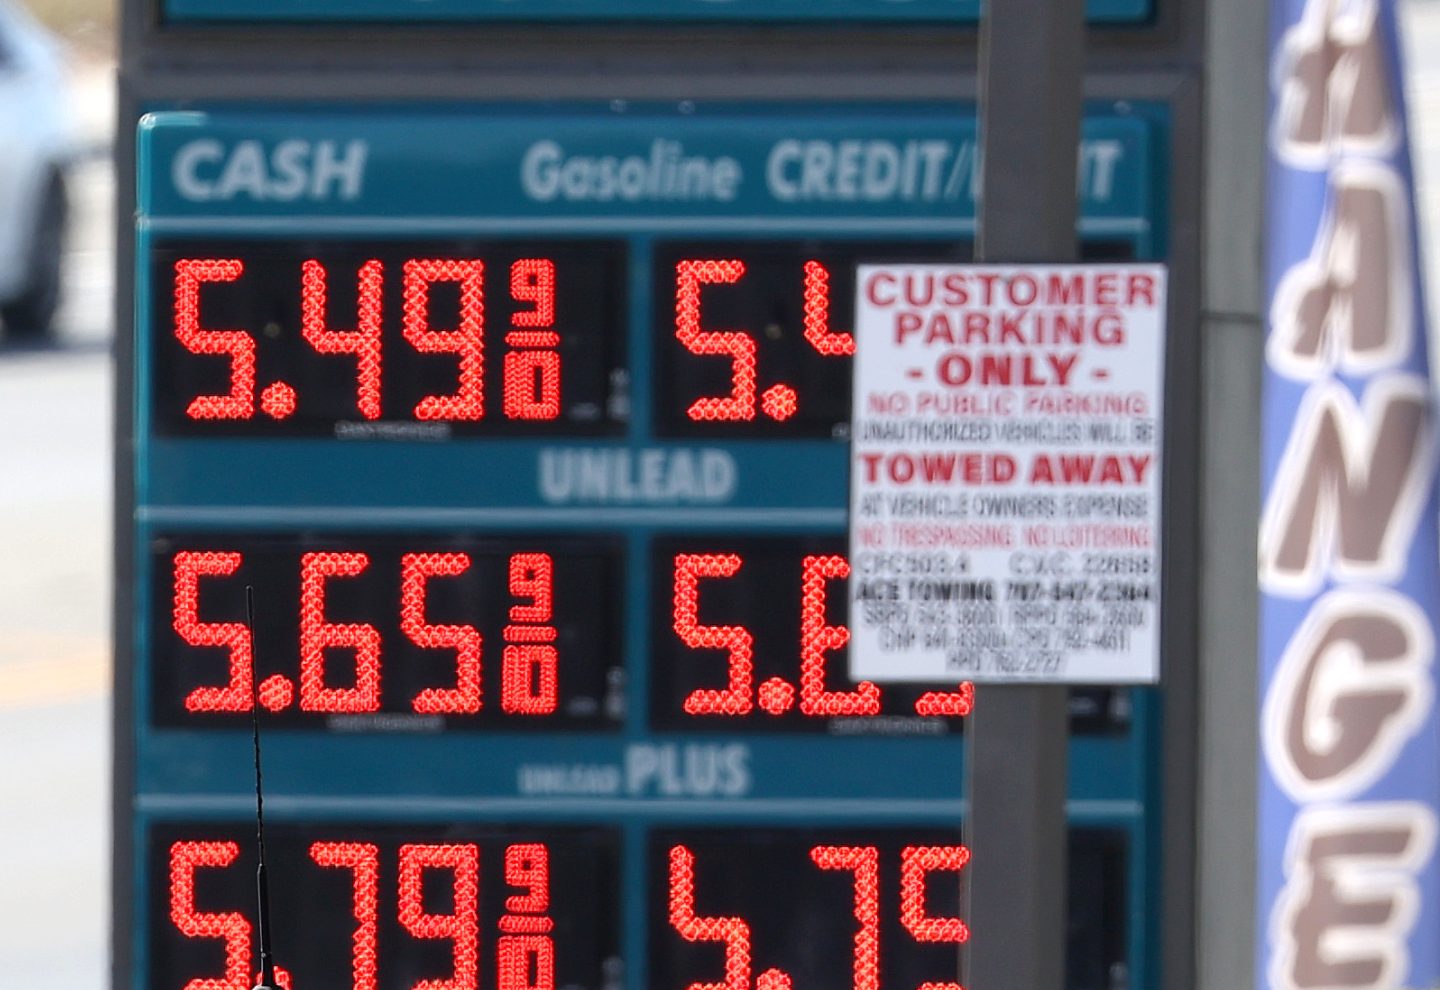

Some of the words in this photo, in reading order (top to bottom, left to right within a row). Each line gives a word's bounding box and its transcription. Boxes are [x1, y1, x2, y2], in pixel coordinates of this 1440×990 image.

[171, 140, 367, 200] CASH
[521, 139, 740, 200] Gasoline
[866, 273, 1155, 306] CUSTOMER
[894, 313, 1125, 345] PARKING
[937, 354, 1079, 387] ONLY
[868, 392, 910, 415] NO
[916, 392, 1015, 415] PUBLIC
[1024, 392, 1148, 415] PARKING
[864, 420, 992, 443] UNAUTHORIZED
[995, 420, 1083, 443] VEHICLES
[1089, 420, 1127, 443] WILL
[538, 448, 737, 501] UNLEAD
[862, 454, 1016, 484] TOWED
[1029, 454, 1150, 484] AWAY
[861, 494, 883, 517] AT
[889, 494, 968, 517] VEHICLE
[1062, 494, 1149, 518] EXPENSE
[859, 524, 884, 547] NO
[891, 524, 1013, 547] TRESPASSING
[627, 744, 750, 794] PLUS
